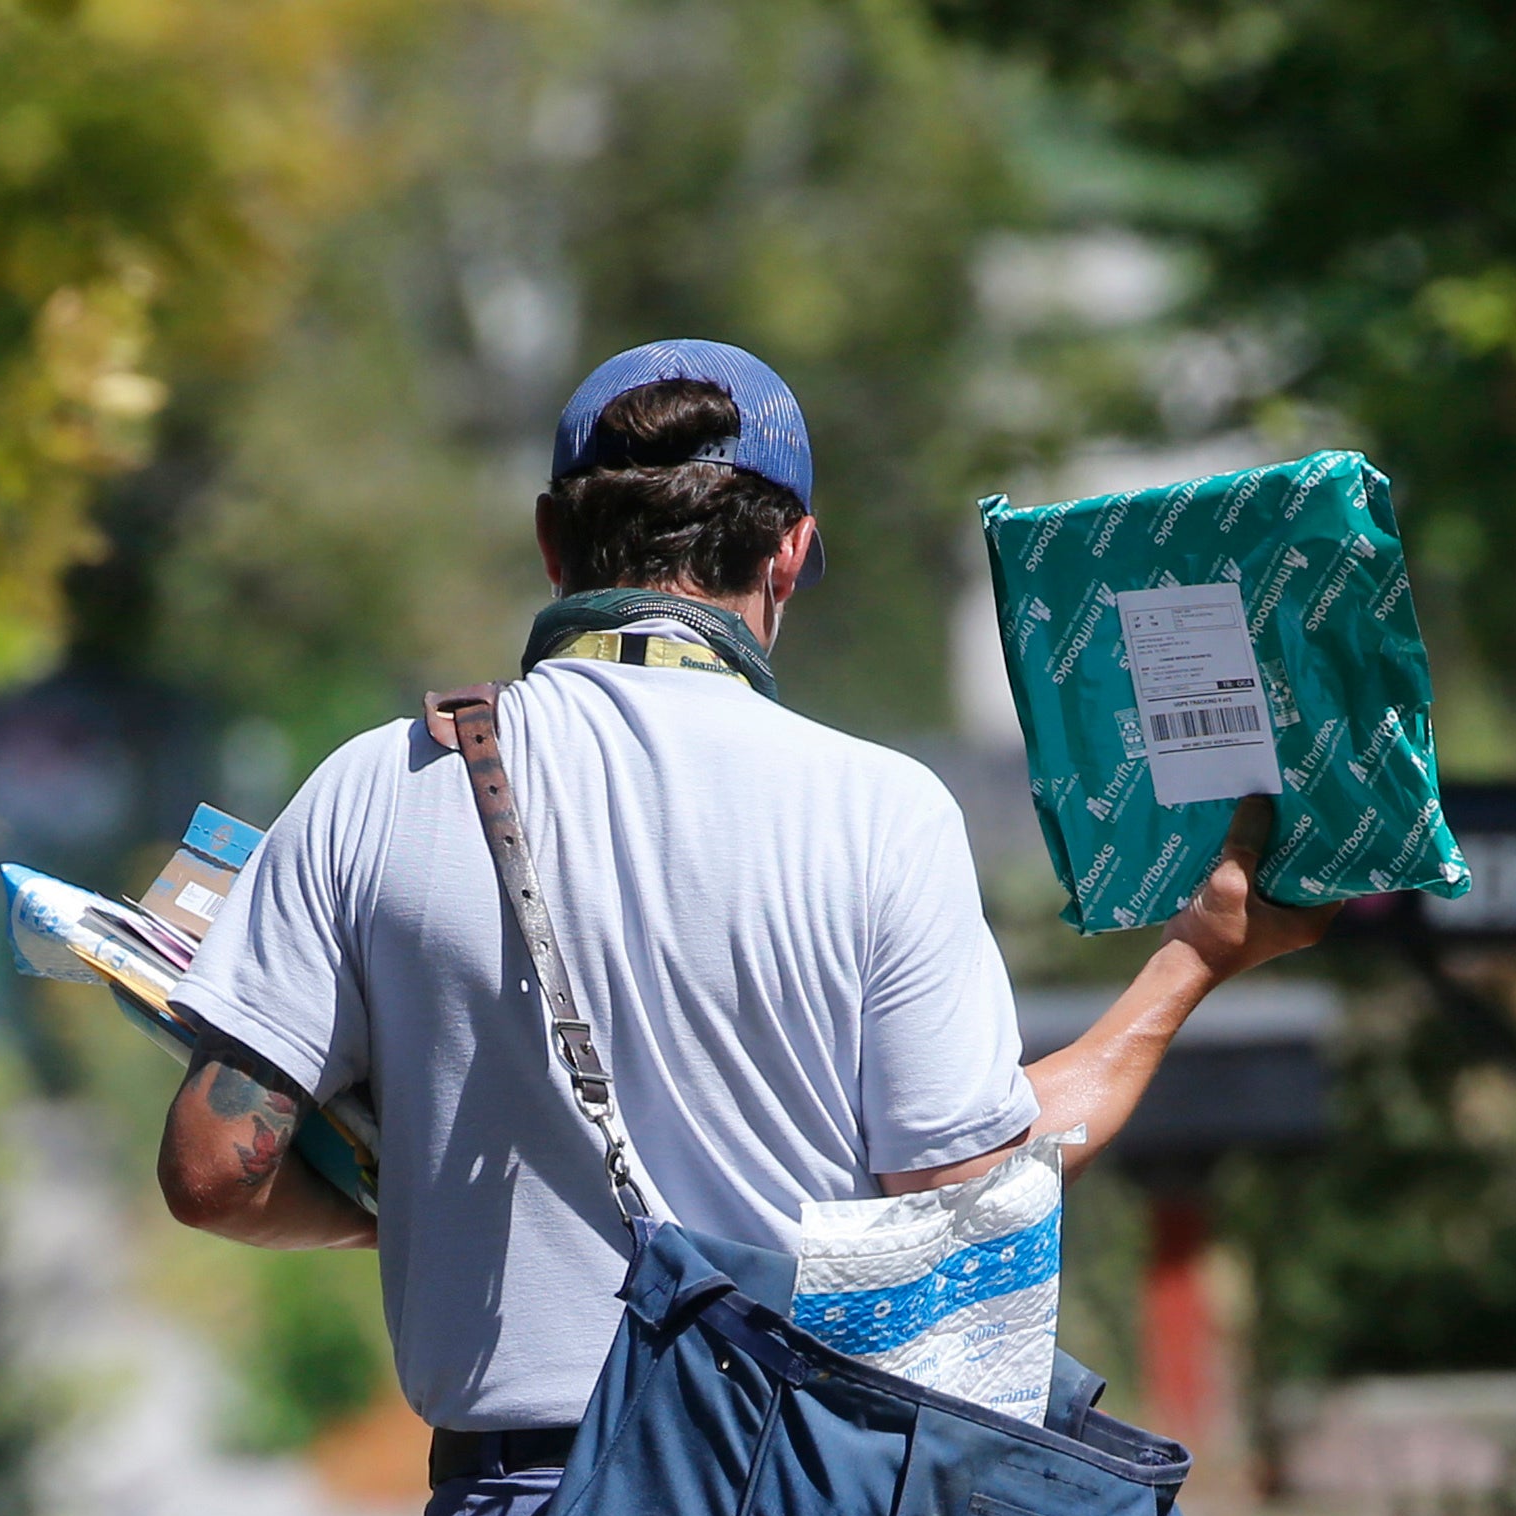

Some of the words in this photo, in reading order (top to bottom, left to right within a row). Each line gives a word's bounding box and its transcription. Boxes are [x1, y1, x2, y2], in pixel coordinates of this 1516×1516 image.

[1304, 554, 1360, 636] thriftbooks
[1050, 603, 1105, 687] thriftbooks
[1127, 830, 1183, 911] thriftbooks
[1318, 804, 1379, 881] thriftbooks
[1389, 796, 1441, 873] thriftbooks
[962, 1319, 1008, 1348] prime
[989, 1385, 1042, 1410] prime
